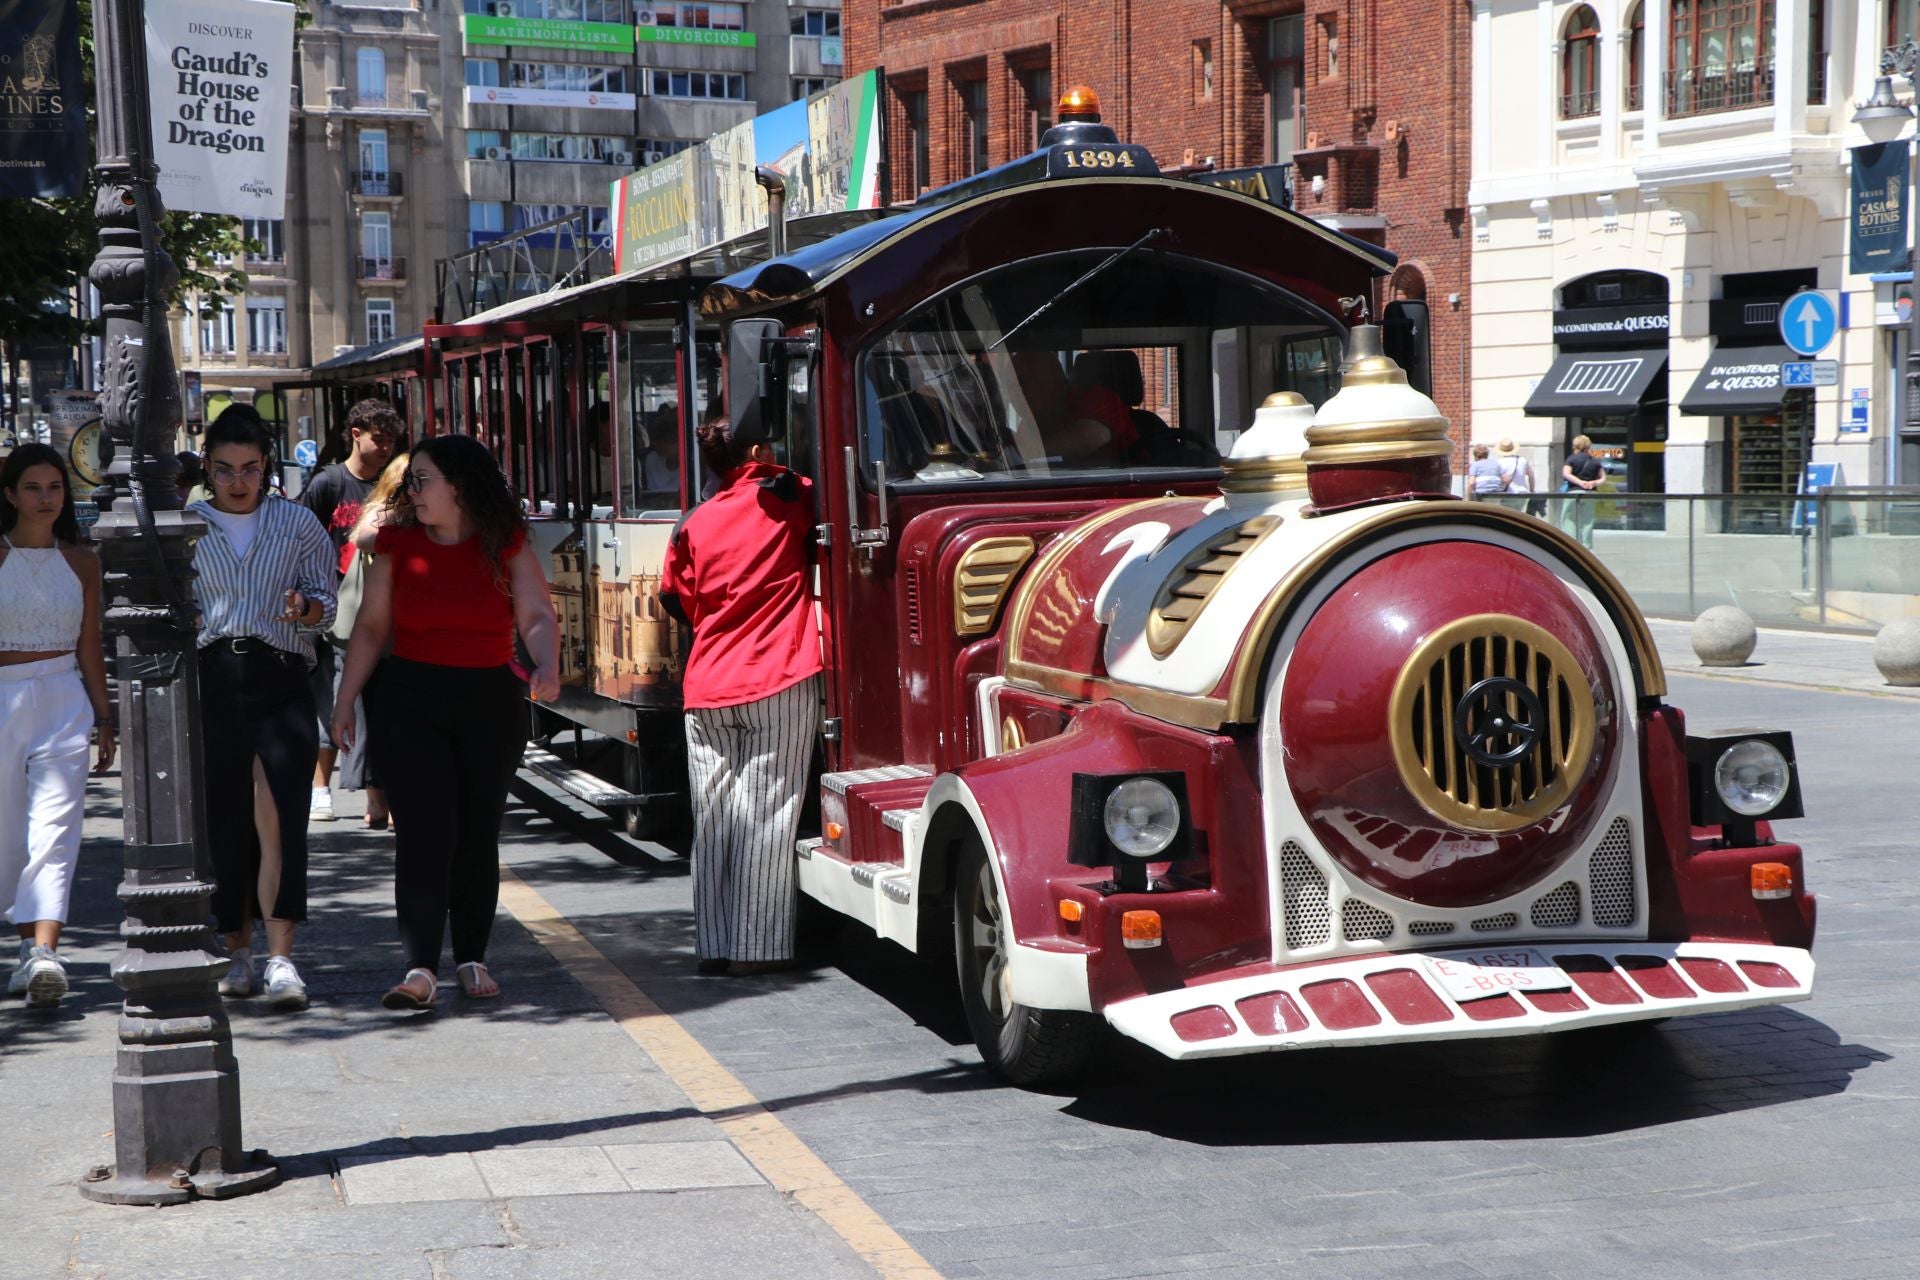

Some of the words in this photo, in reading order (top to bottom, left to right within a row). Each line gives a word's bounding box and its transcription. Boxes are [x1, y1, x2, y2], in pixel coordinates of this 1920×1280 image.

[188, 22, 253, 40] DISCOVER
[486, 25, 618, 43] MATRIMONIALISTA
[656, 28, 739, 45] DIVORCIOS
[171, 46, 268, 78] Gaudí's
[177, 71, 260, 102] House
[179, 98, 208, 121] of
[213, 101, 255, 126] the
[168, 121, 265, 154] Dragon
[1064, 150, 1135, 168] 1894
[1859, 200, 1886, 215] CASA
[1859, 210, 1900, 226] BOTINES
[1553, 325, 1565, 334] UN
[1565, 322, 1613, 334] CONTENEDOR
[1613, 320, 1624, 331] de
[1624, 315, 1669, 332] QUESOS
[1711, 366, 1726, 376] UN
[1705, 379, 1721, 390] de
[1722, 375, 1780, 392] QUESOS
[56, 412, 87, 422] SALIDA
[1435, 960, 1457, 976] E
[1467, 953, 1530, 970] 1657
